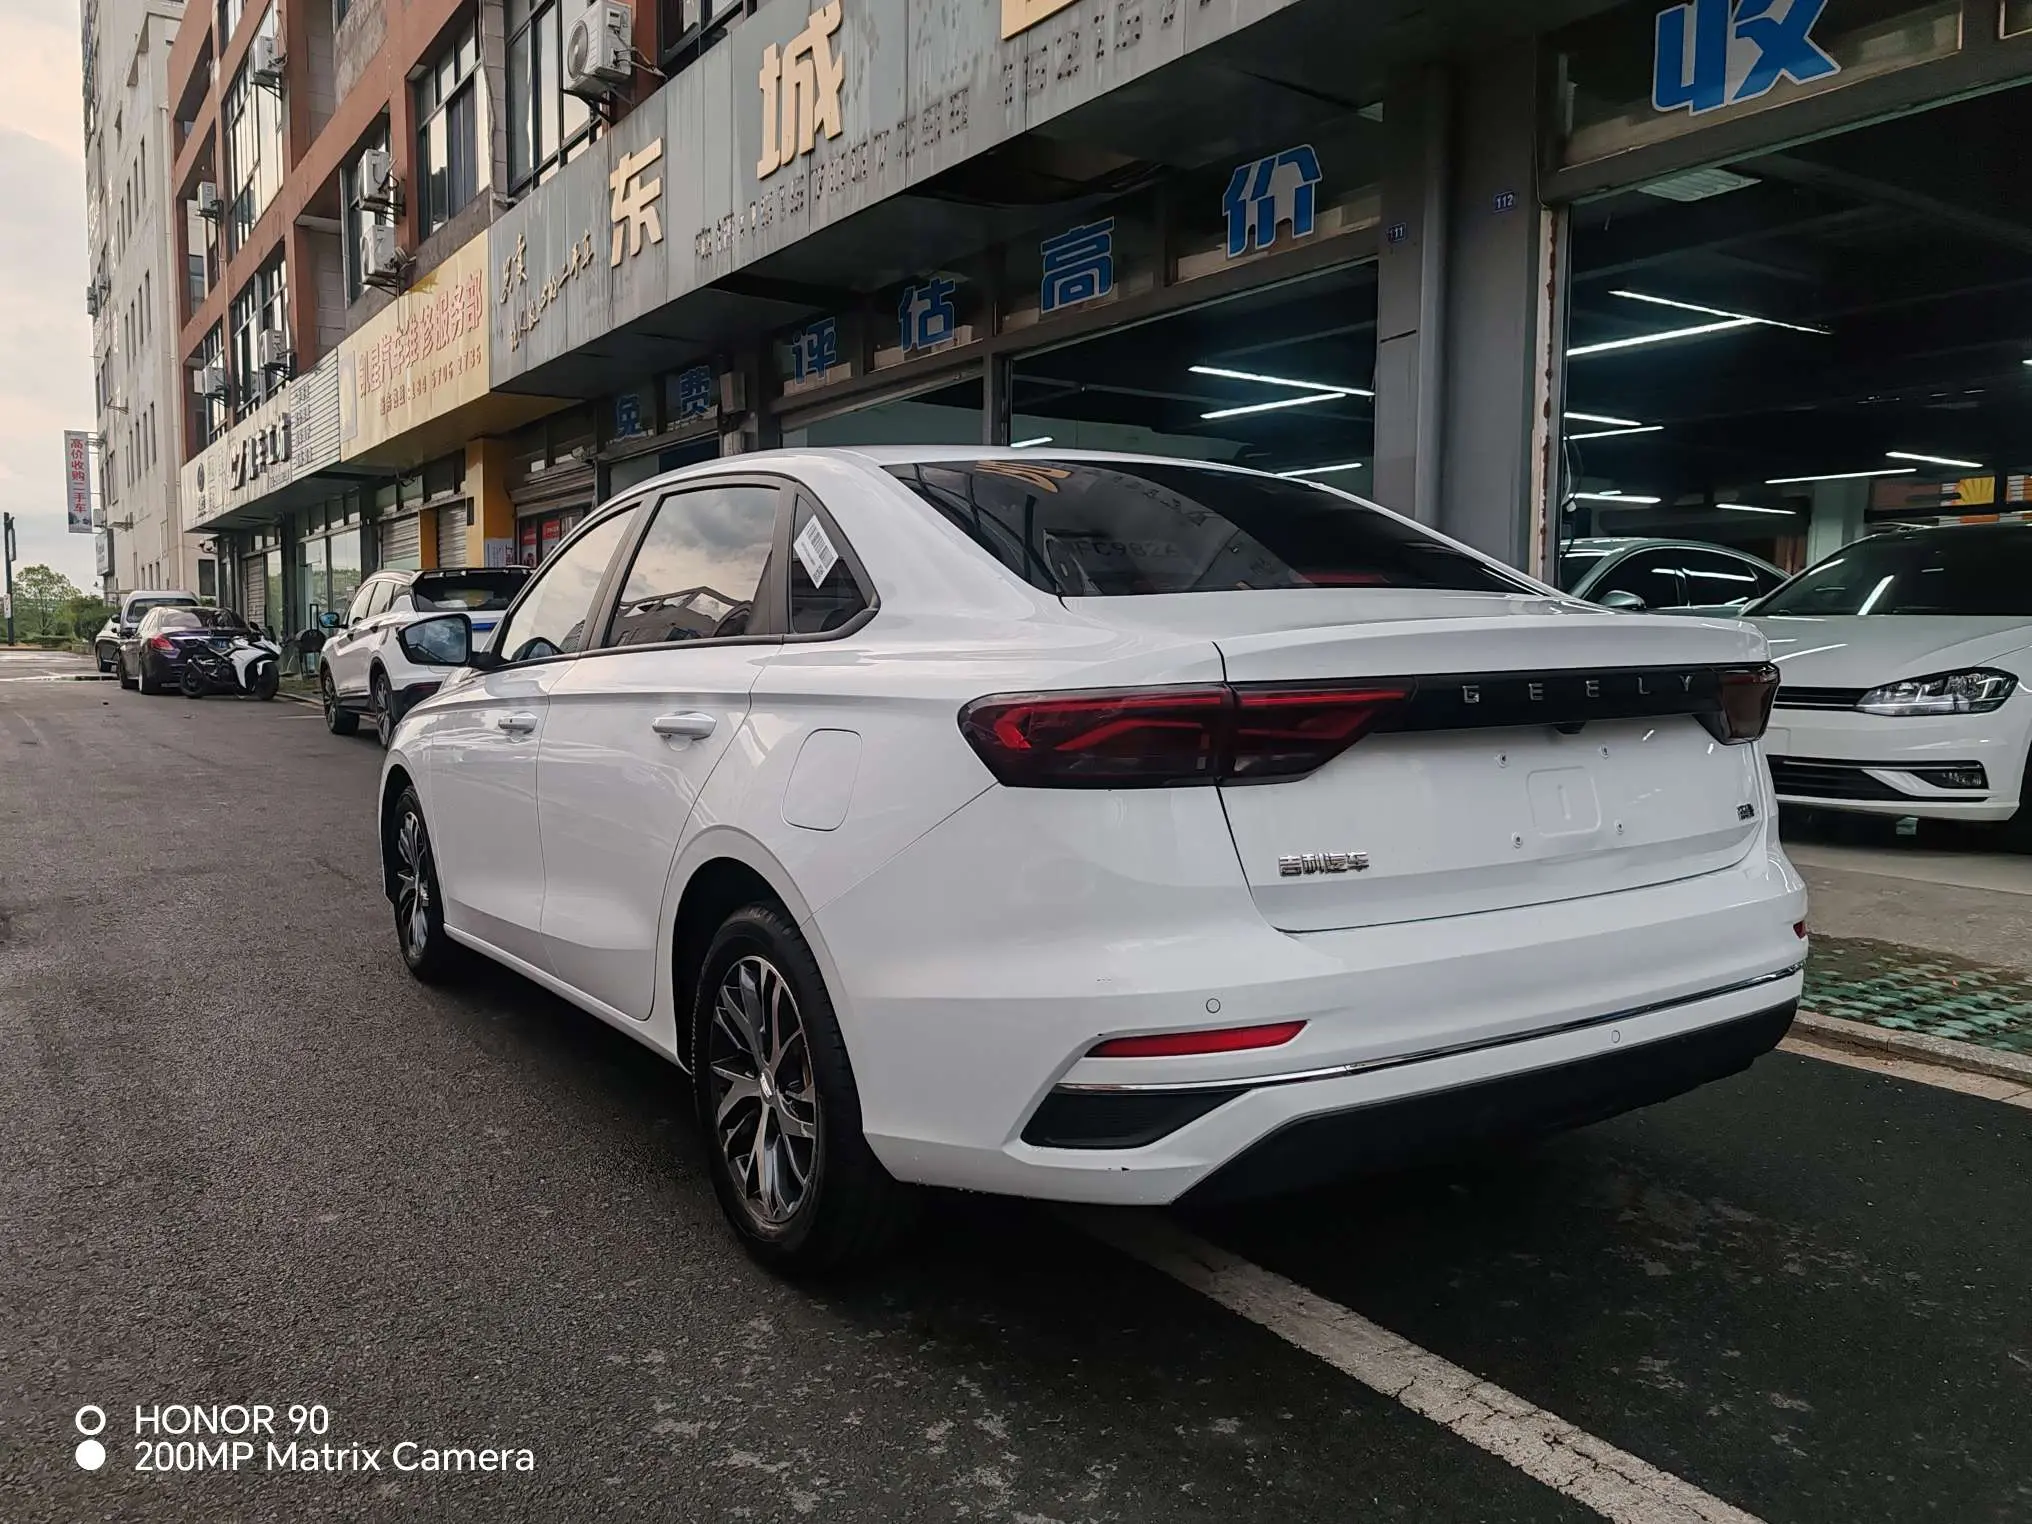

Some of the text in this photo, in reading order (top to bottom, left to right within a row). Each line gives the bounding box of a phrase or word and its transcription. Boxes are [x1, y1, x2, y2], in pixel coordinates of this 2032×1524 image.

[1496, 193, 1514, 209] 112
[70, 438, 87, 514] 高价收购二手车
[1462, 675, 1694, 703] GEELY
[1279, 852, 1370, 876] 吉利汽车
